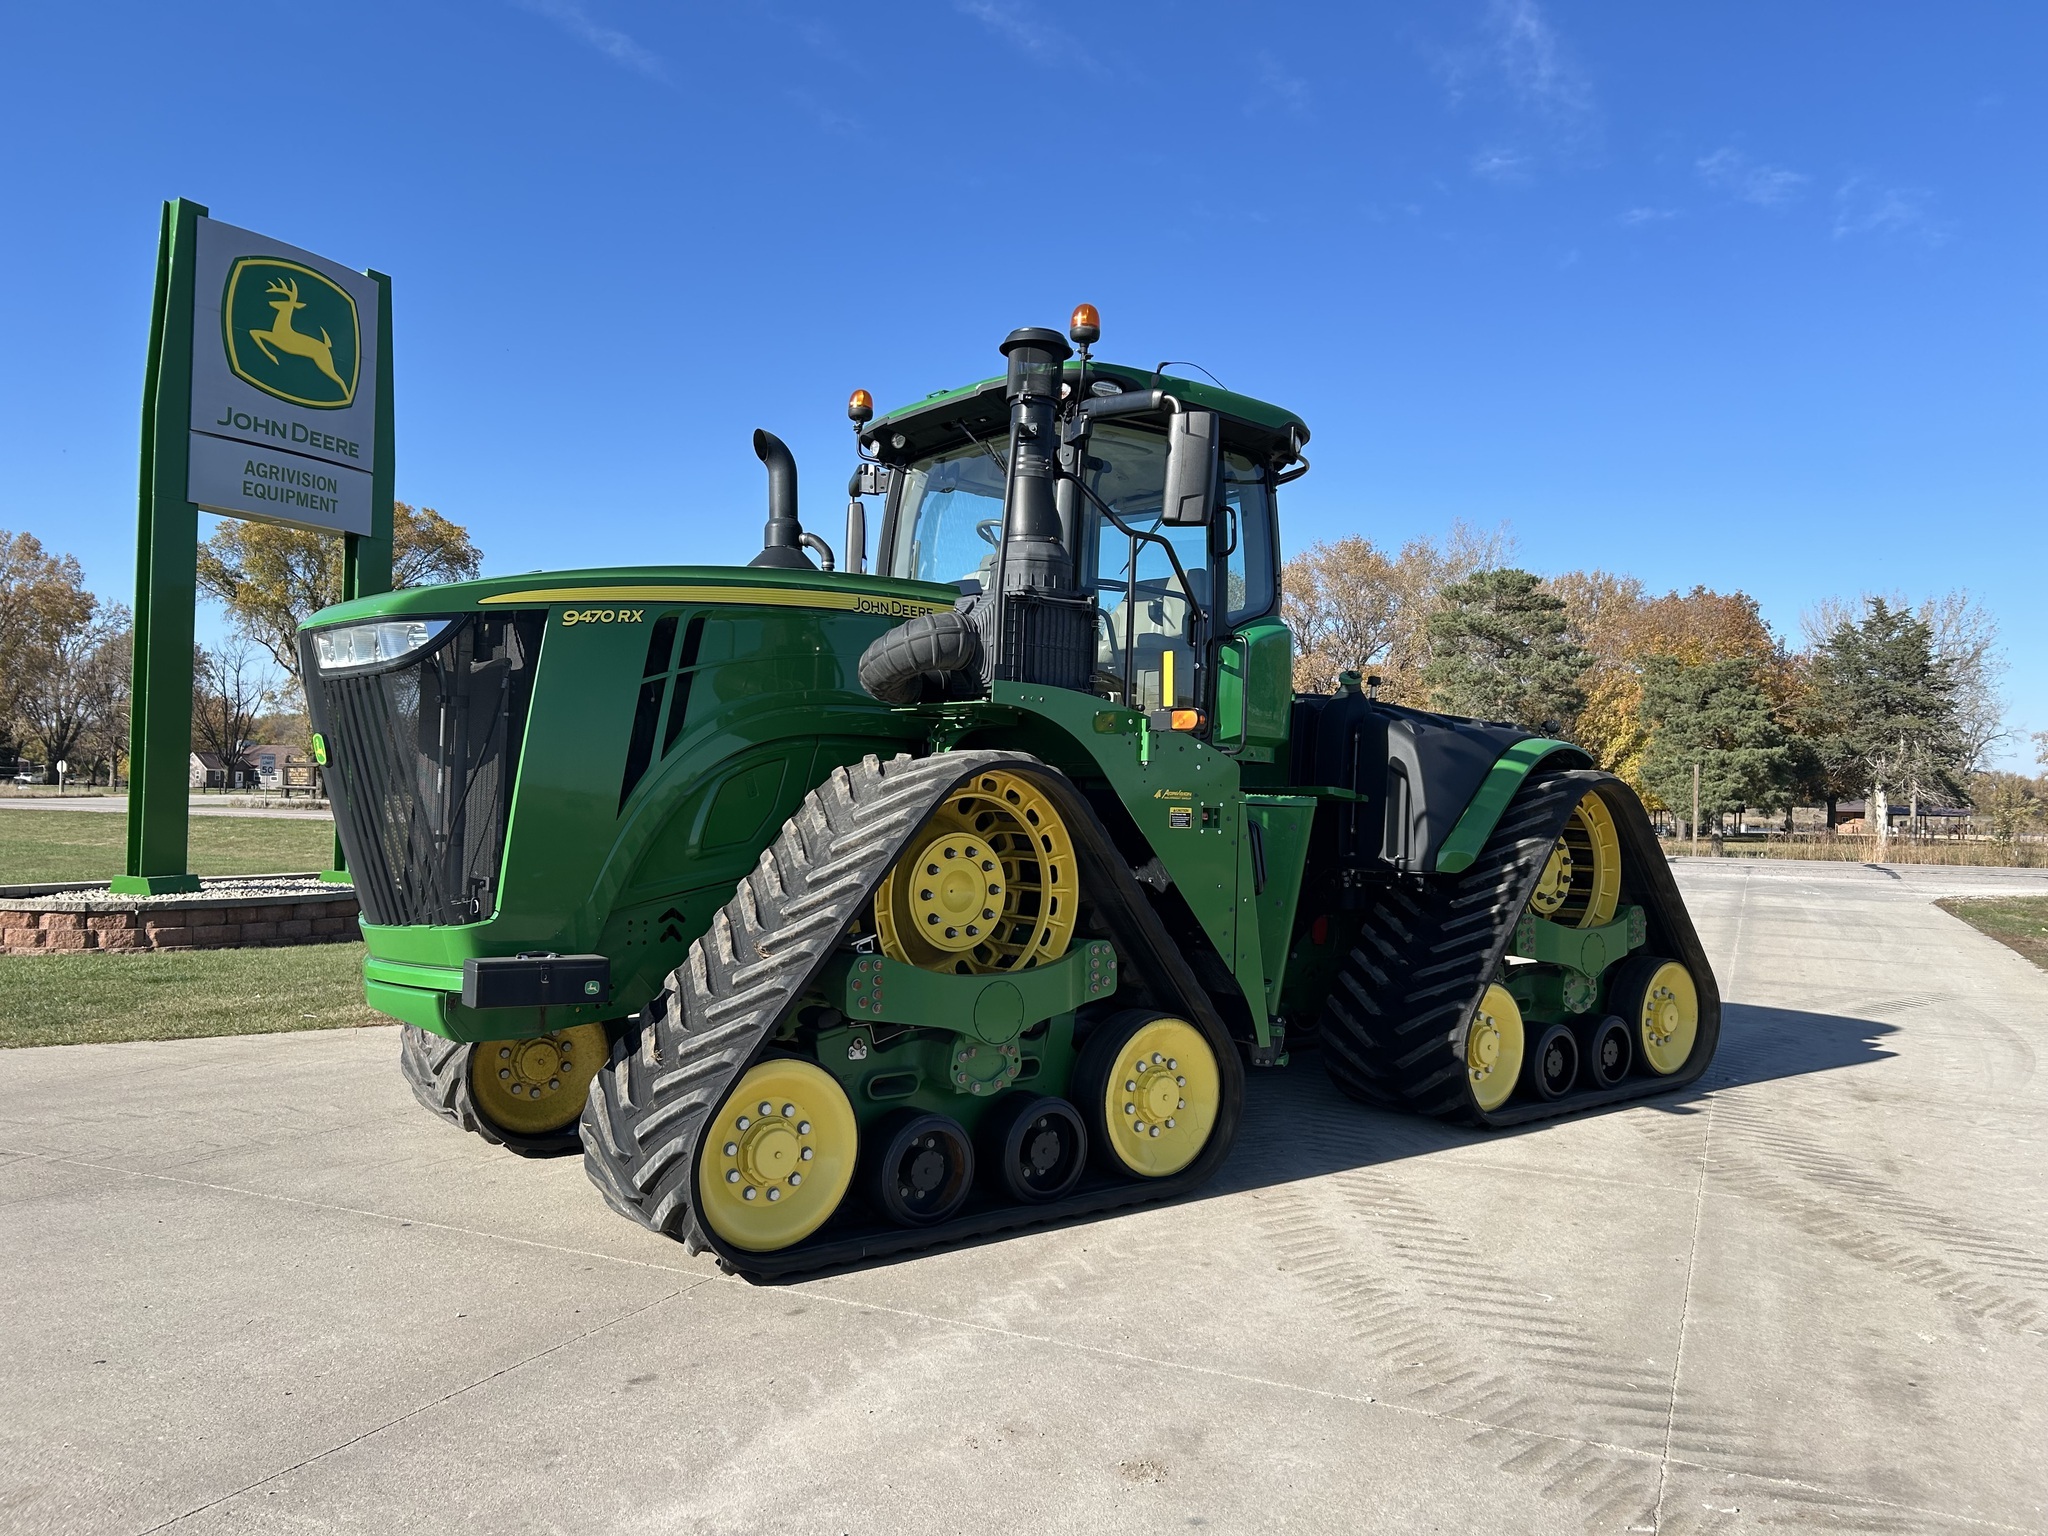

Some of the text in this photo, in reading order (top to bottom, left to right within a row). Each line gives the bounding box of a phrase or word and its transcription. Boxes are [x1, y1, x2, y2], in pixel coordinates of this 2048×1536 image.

[217, 406, 360, 459] JOHN DEERE
[244, 459, 338, 494] AGRIVISION
[242, 480, 339, 514] EQUIPMENT
[562, 609, 645, 626] 9470 RX
[853, 597, 934, 618] JOHN DEERE
[261, 765, 274, 774] 50
